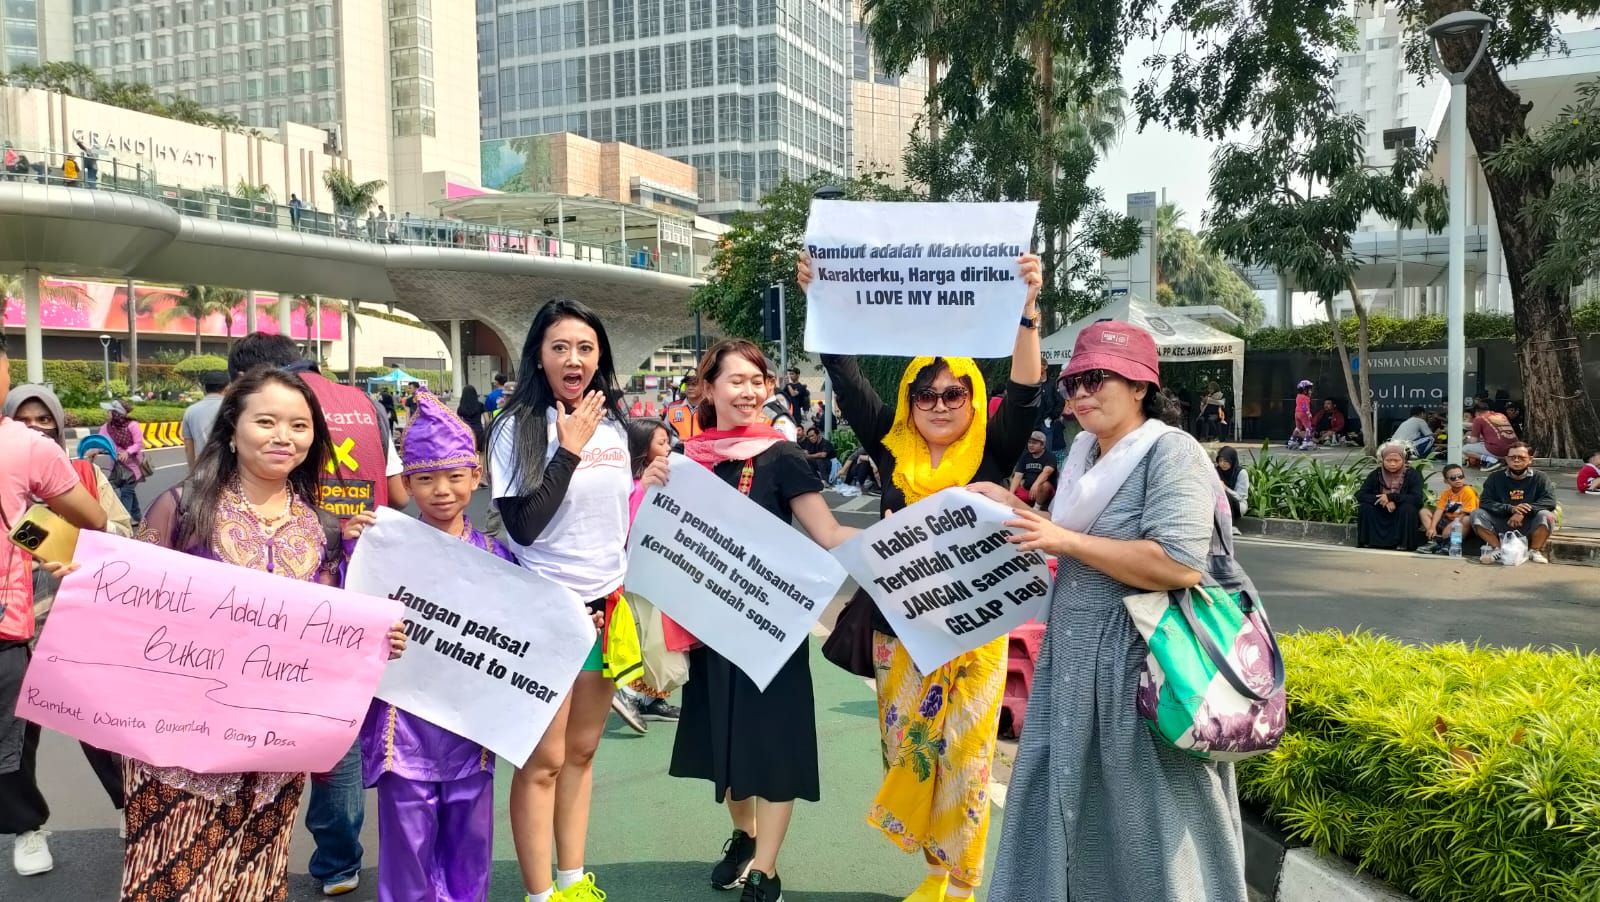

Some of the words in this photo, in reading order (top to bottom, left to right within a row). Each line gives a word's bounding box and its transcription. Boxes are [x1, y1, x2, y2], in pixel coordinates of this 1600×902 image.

[72, 128, 146, 155] GRAND
[156, 143, 217, 168] HYATT
[808, 244, 867, 259] Rambut
[870, 243, 923, 259] adalah
[927, 243, 1024, 258] Mahkotaku.
[818, 266, 904, 285] Karakterku,
[908, 267, 956, 285] Harga
[960, 266, 1015, 282] diriku.
[856, 291, 862, 305] I
[866, 291, 903, 305] LOVE
[908, 291, 932, 305] MY
[937, 291, 975, 306] HAIR
[1187, 345, 1212, 356] SAWAH
[1403, 355, 1473, 367] NUSANTA
[1369, 384, 1443, 399] ullma
[322, 407, 374, 425] karta
[321, 484, 370, 500] perasi
[652, 492, 681, 516] Kita
[680, 510, 747, 562] penduduk
[747, 554, 815, 611] Nusantara
[871, 525, 928, 560] Habis
[925, 505, 977, 536] Gelap
[640, 534, 705, 584] Kerudung
[705, 578, 745, 612] sudah
[746, 608, 787, 642] sopan
[674, 528, 728, 575] beriklim
[729, 568, 770, 606] tropis.
[873, 550, 955, 594] Terbitlah
[93, 560, 196, 611] Rambut
[300, 600, 365, 650] Aura
[388, 585, 462, 628] Jangan
[461, 618, 531, 658] paksa!
[902, 580, 974, 620] JANGAN
[945, 599, 1005, 636] GELAP
[1004, 575, 1048, 606] lagi
[144, 625, 225, 670] Bukan
[242, 644, 314, 683] Aurat
[402, 618, 434, 646] OW
[435, 637, 485, 670] what
[486, 658, 507, 680] to
[510, 671, 559, 704] wear
[27, 686, 84, 721] Rambut
[93, 713, 146, 729] Wanita
[264, 731, 297, 748] Dosa
